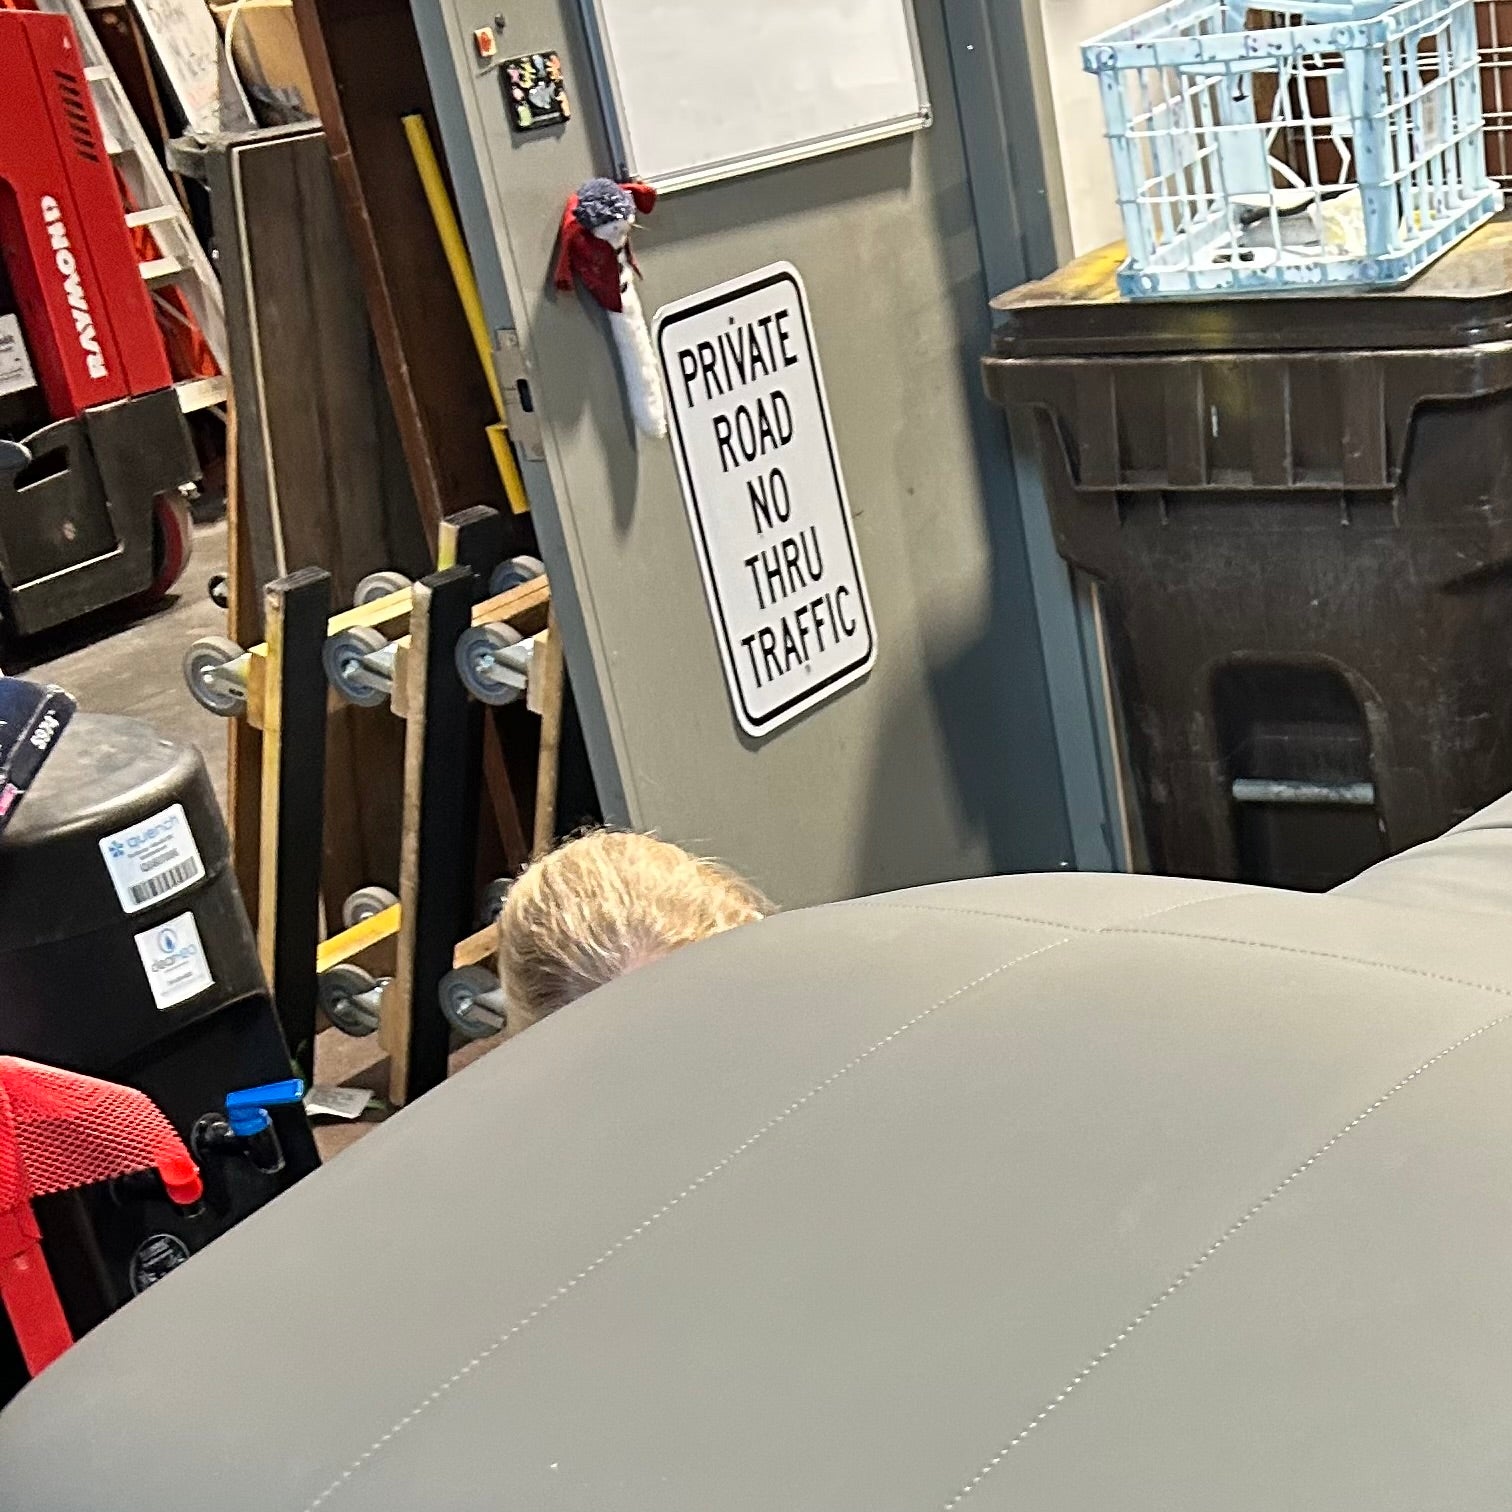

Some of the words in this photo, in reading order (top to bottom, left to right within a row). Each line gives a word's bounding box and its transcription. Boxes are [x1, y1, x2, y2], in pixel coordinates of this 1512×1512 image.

[41, 195, 108, 379] RAYMOND
[678, 309, 798, 408] PRIVATE
[713, 390, 793, 472] ROAD
[746, 468, 791, 533] NO
[744, 526, 822, 609] THRU
[741, 585, 856, 688] TRAFFIC
